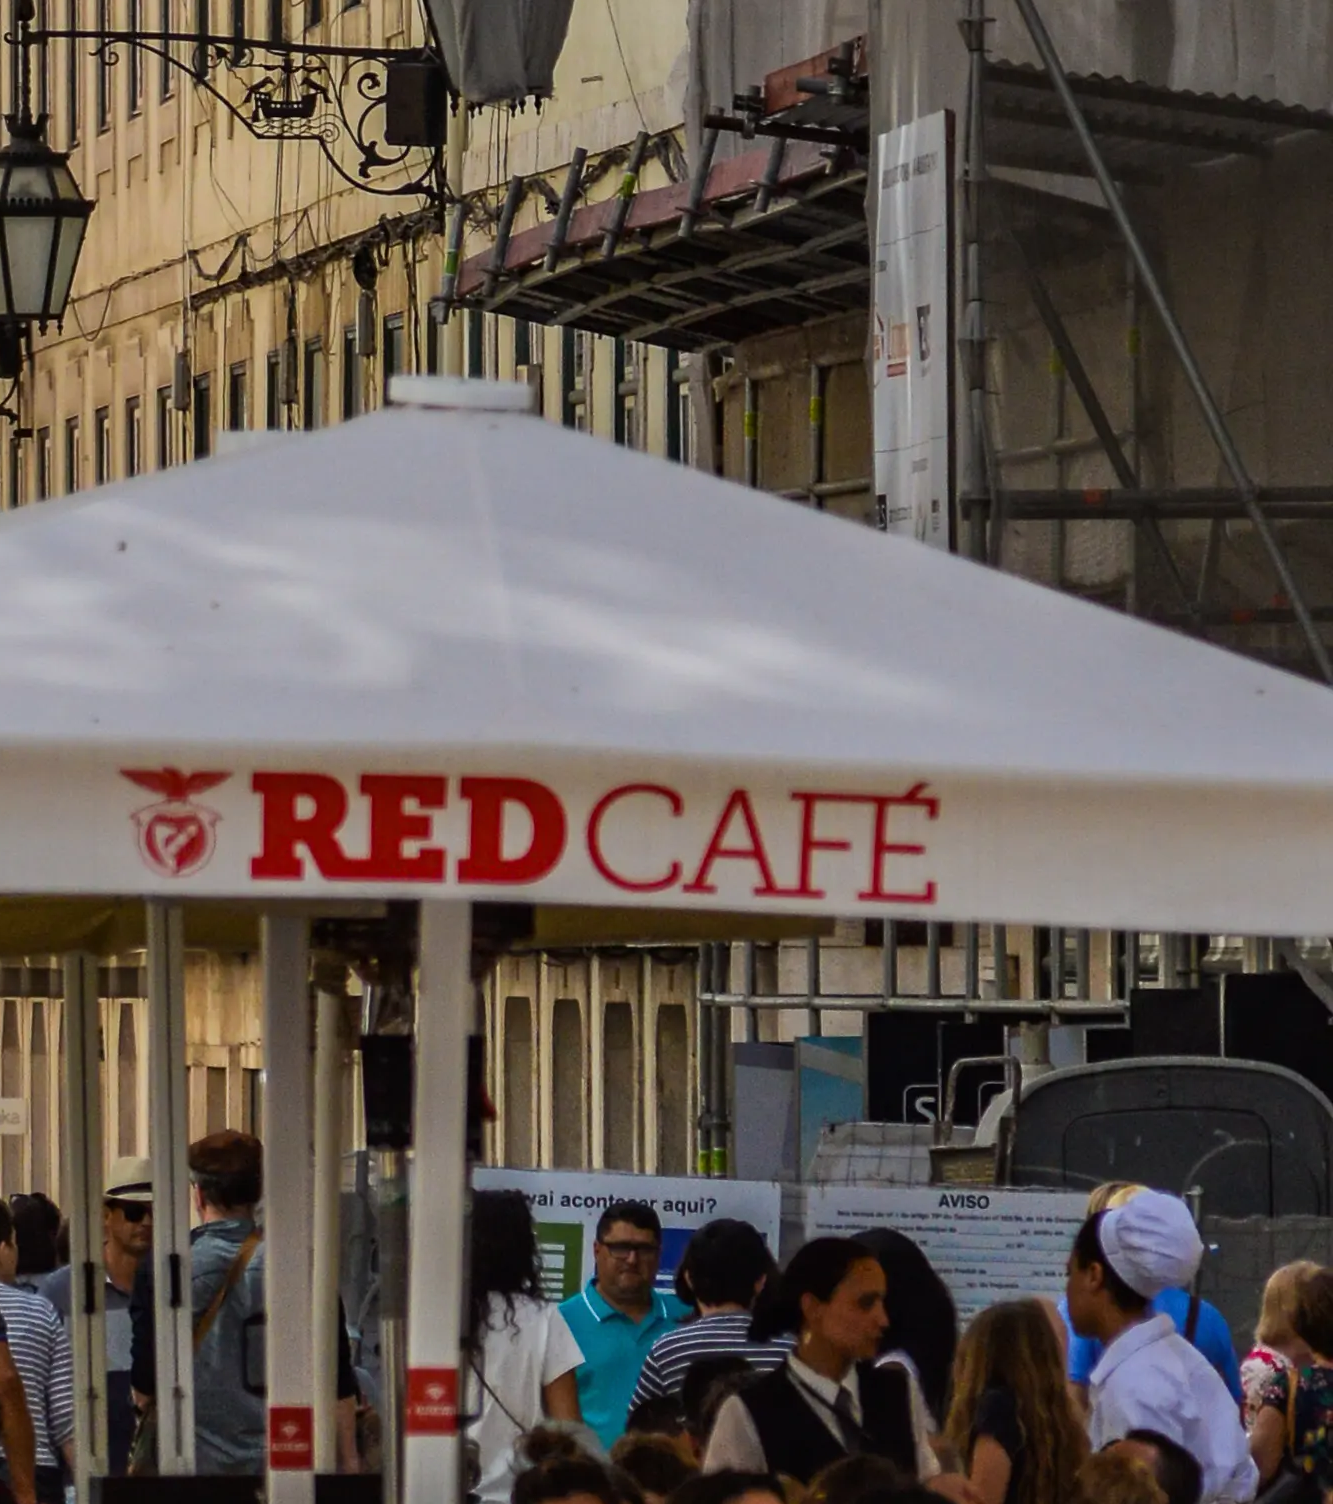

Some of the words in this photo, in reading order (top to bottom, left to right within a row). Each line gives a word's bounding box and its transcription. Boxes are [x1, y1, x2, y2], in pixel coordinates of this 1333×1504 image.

[250, 771, 567, 884] RED
[585, 780, 939, 905] CAFÉ
[663, 1197, 717, 1214] aqui?
[938, 1194, 990, 1210] AVISO
